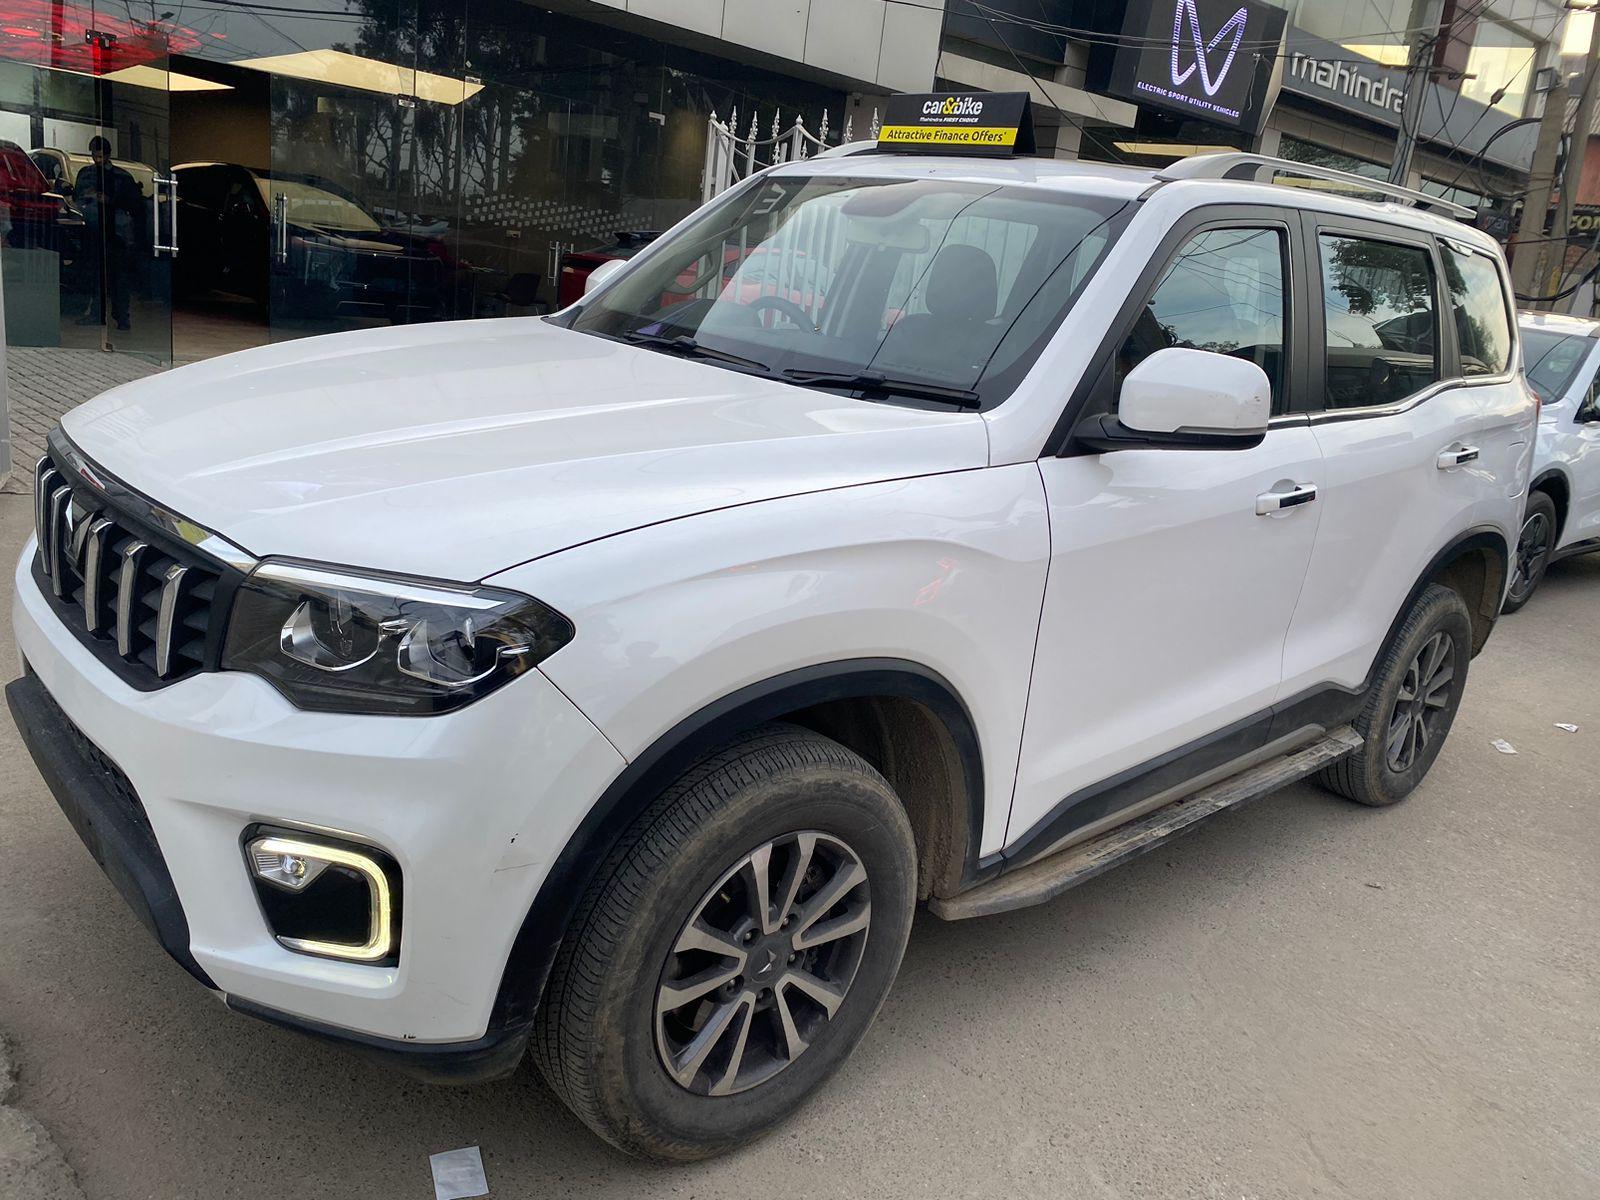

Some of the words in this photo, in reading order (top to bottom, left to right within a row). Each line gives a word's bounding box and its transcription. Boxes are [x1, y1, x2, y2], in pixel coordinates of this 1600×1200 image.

[1291, 51, 1408, 113] mahindra
[922, 97, 983, 115] car&bike
[1137, 81, 1167, 96] ELECTRIC
[1168, 91, 1188, 102] SPORT
[1188, 97, 1212, 109] UTILITY
[1212, 104, 1240, 118] VEHICLES
[887, 129, 932, 140] Attractive
[933, 130, 968, 141] Finance
